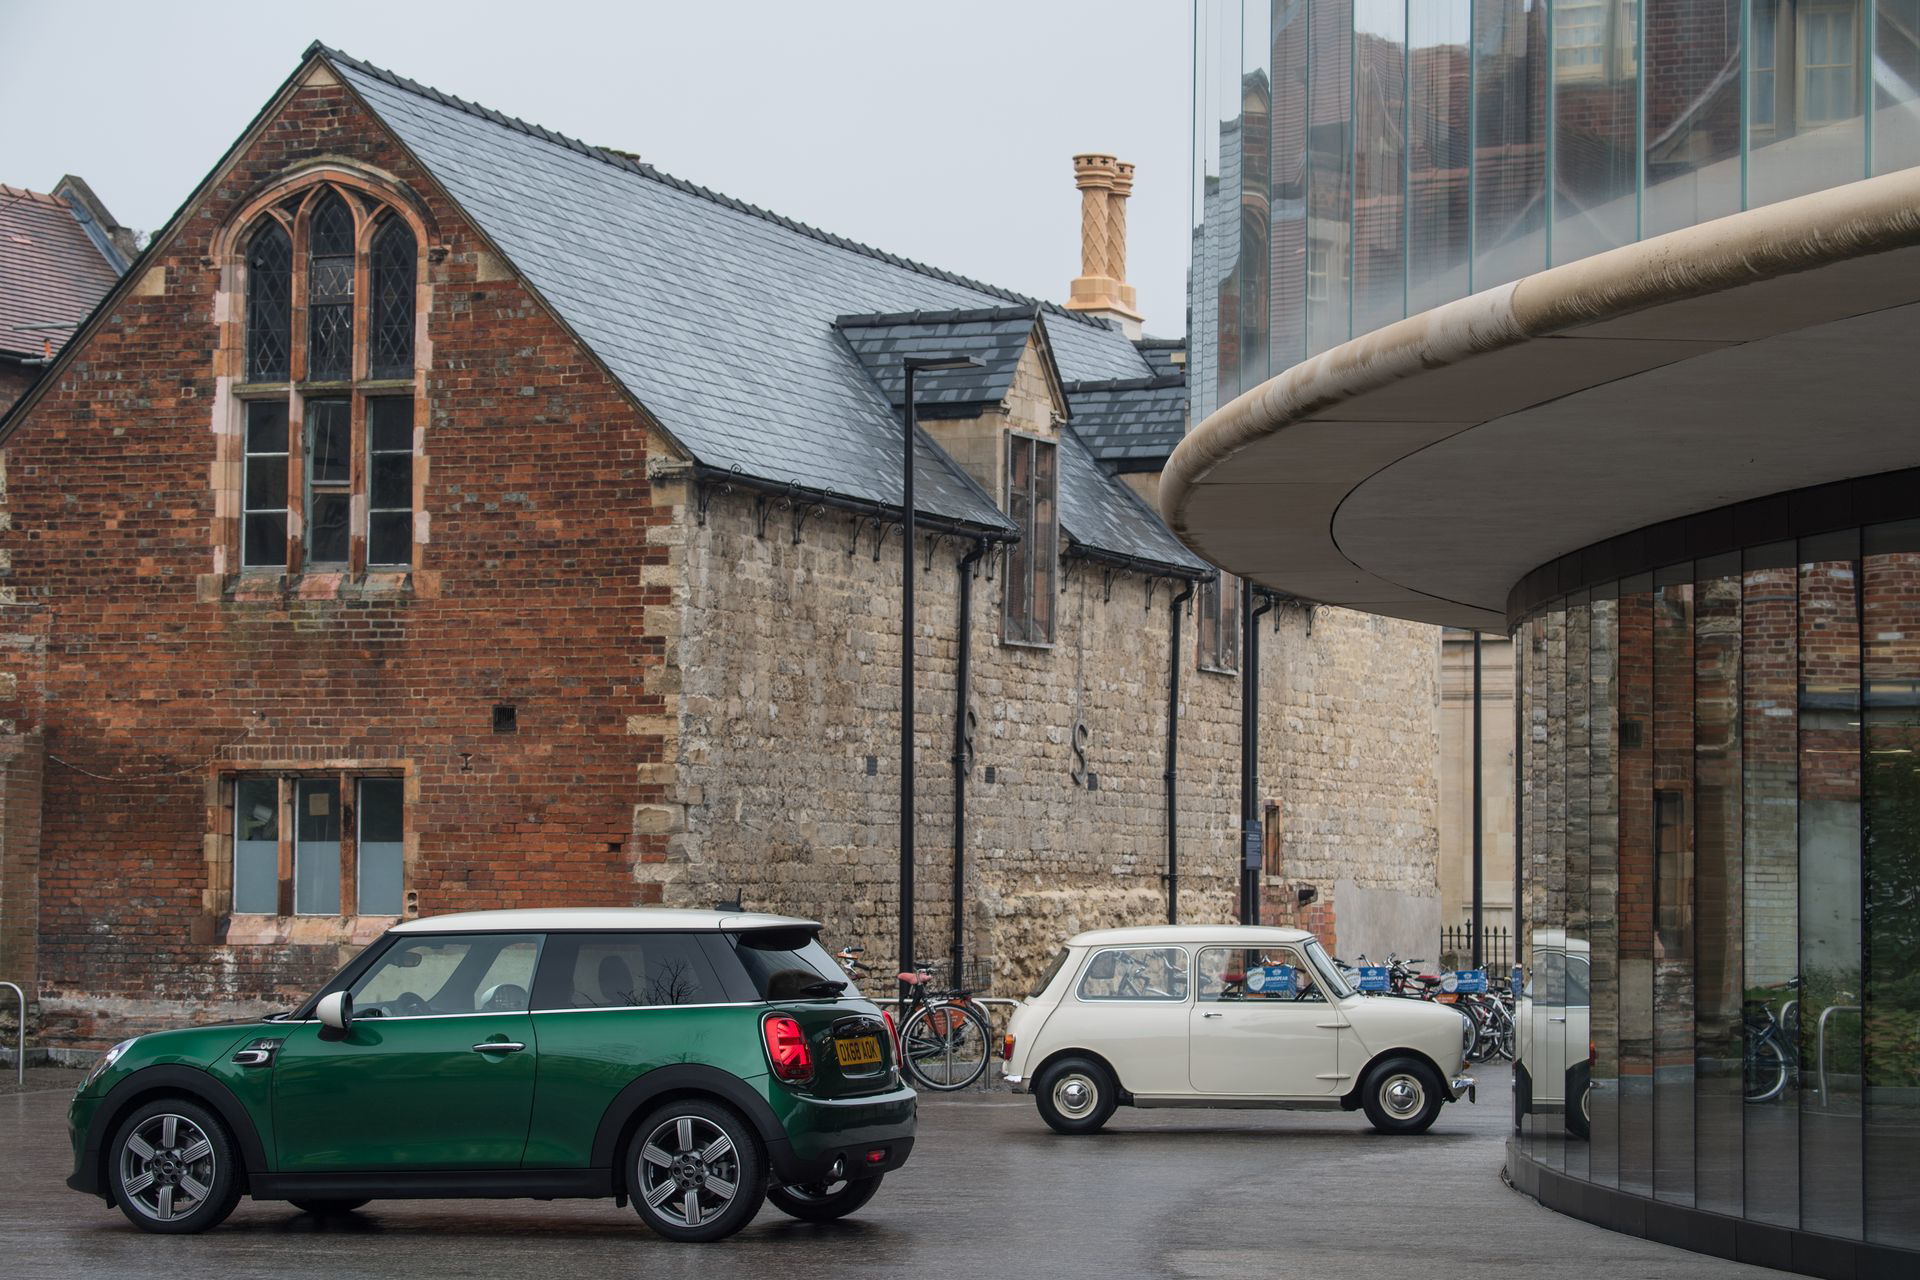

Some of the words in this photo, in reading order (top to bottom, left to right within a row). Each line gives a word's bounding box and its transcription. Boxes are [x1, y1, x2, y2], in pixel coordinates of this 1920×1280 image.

[260, 1040, 274, 1049] 60
[839, 1042, 862, 1062] OX68
[862, 1040, 878, 1060] AOK
